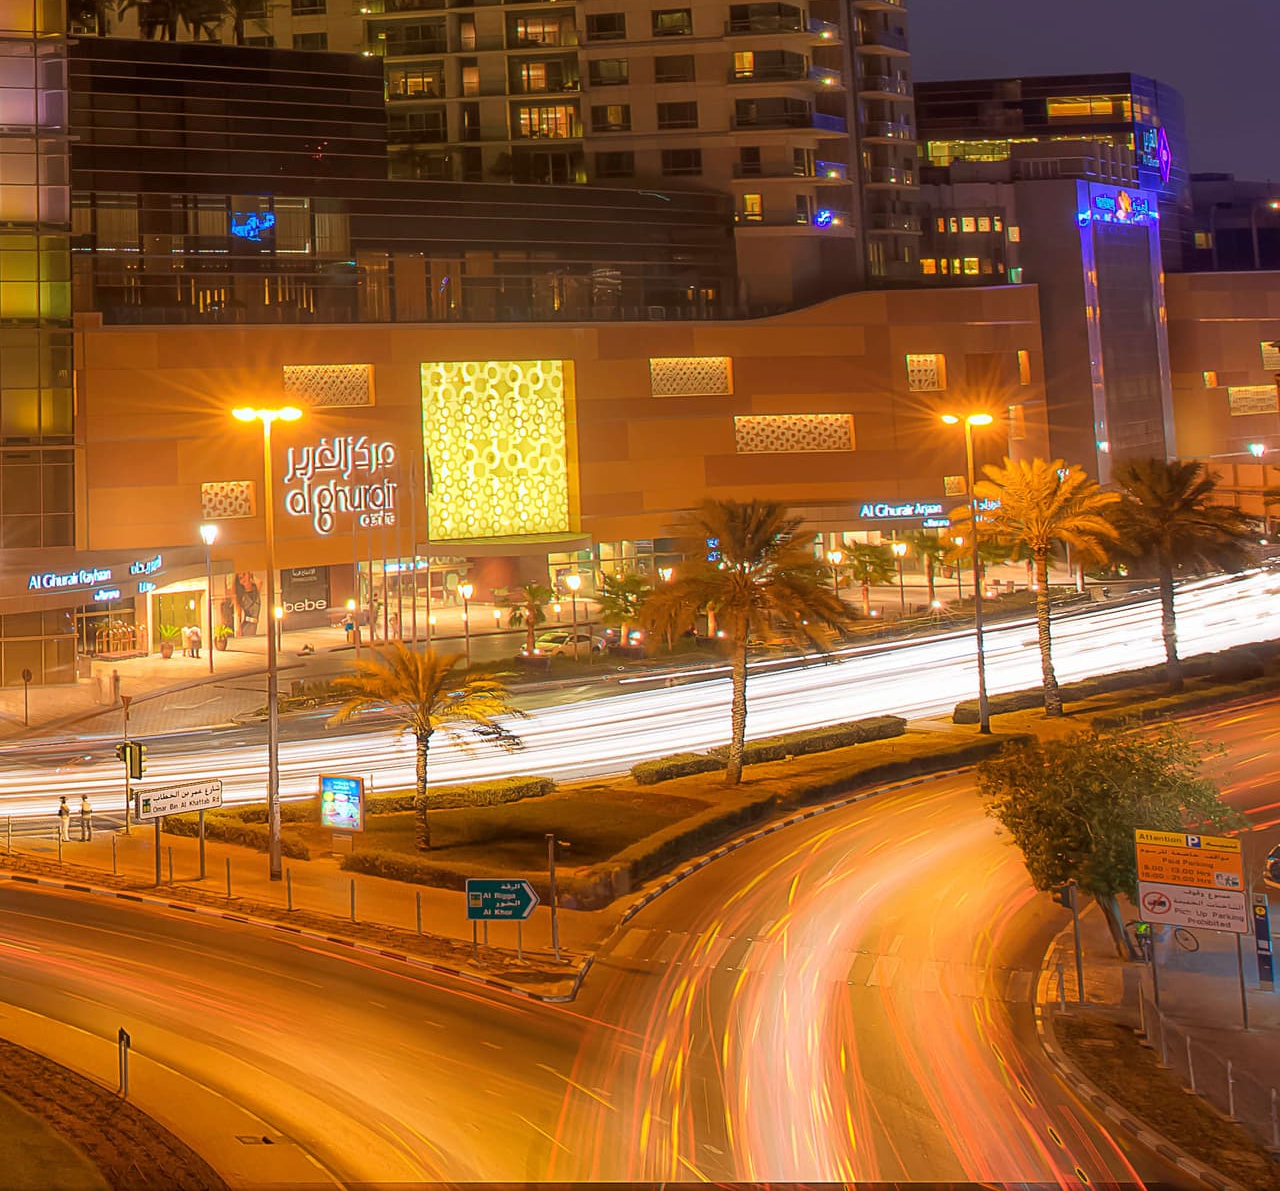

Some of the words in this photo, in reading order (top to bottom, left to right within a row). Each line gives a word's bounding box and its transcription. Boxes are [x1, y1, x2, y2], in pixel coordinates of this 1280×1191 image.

[283, 436, 346, 484] الغرير
[342, 436, 396, 480] مركز
[313, 478, 398, 535] ghurair
[29, 575, 41, 590] Al
[42, 572, 80, 588] Ghurair
[283, 598, 327, 613] bebe
[152, 805, 167, 813] Omar
[189, 798, 210, 807] Khattab
[1139, 833, 1182, 843] Attention
[1162, 857, 1181, 865] Paid
[1182, 859, 1214, 869] Parking
[1187, 917, 1232, 928] Prohibited
[1196, 910, 1208, 918] Up
[1212, 912, 1244, 922] Parking
